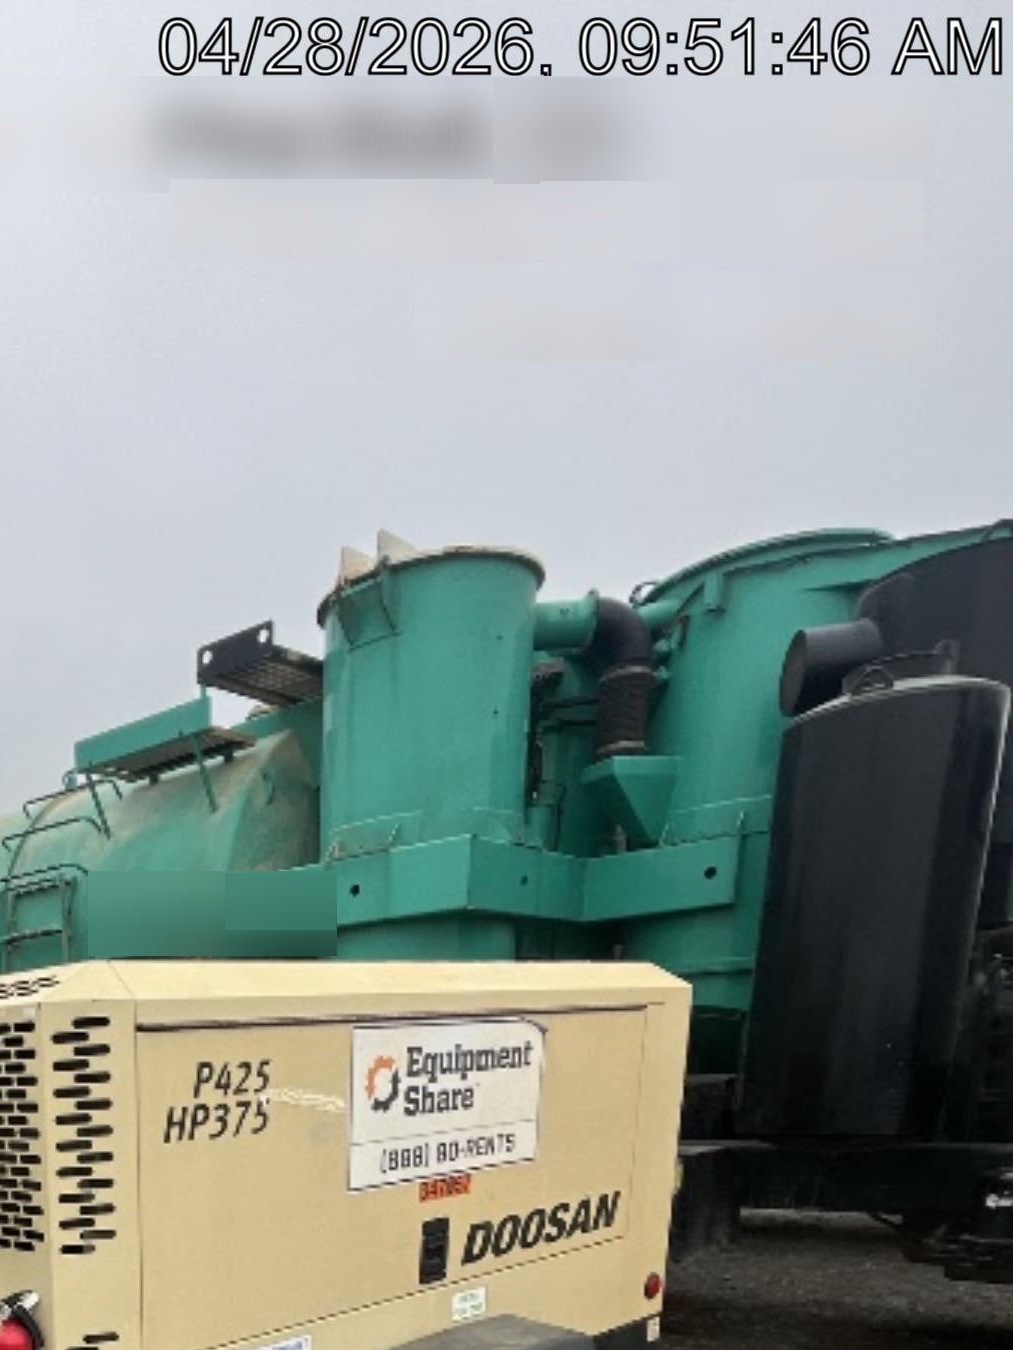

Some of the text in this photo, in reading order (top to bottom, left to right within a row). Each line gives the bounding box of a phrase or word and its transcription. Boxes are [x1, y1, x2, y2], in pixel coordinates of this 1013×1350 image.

[193, 1058, 270, 1098] P425
[406, 1040, 534, 1083] Equipment
[163, 1097, 270, 1144] HP375
[404, 1082, 474, 1116] Share
[461, 1190, 621, 1266] DOOSAN
